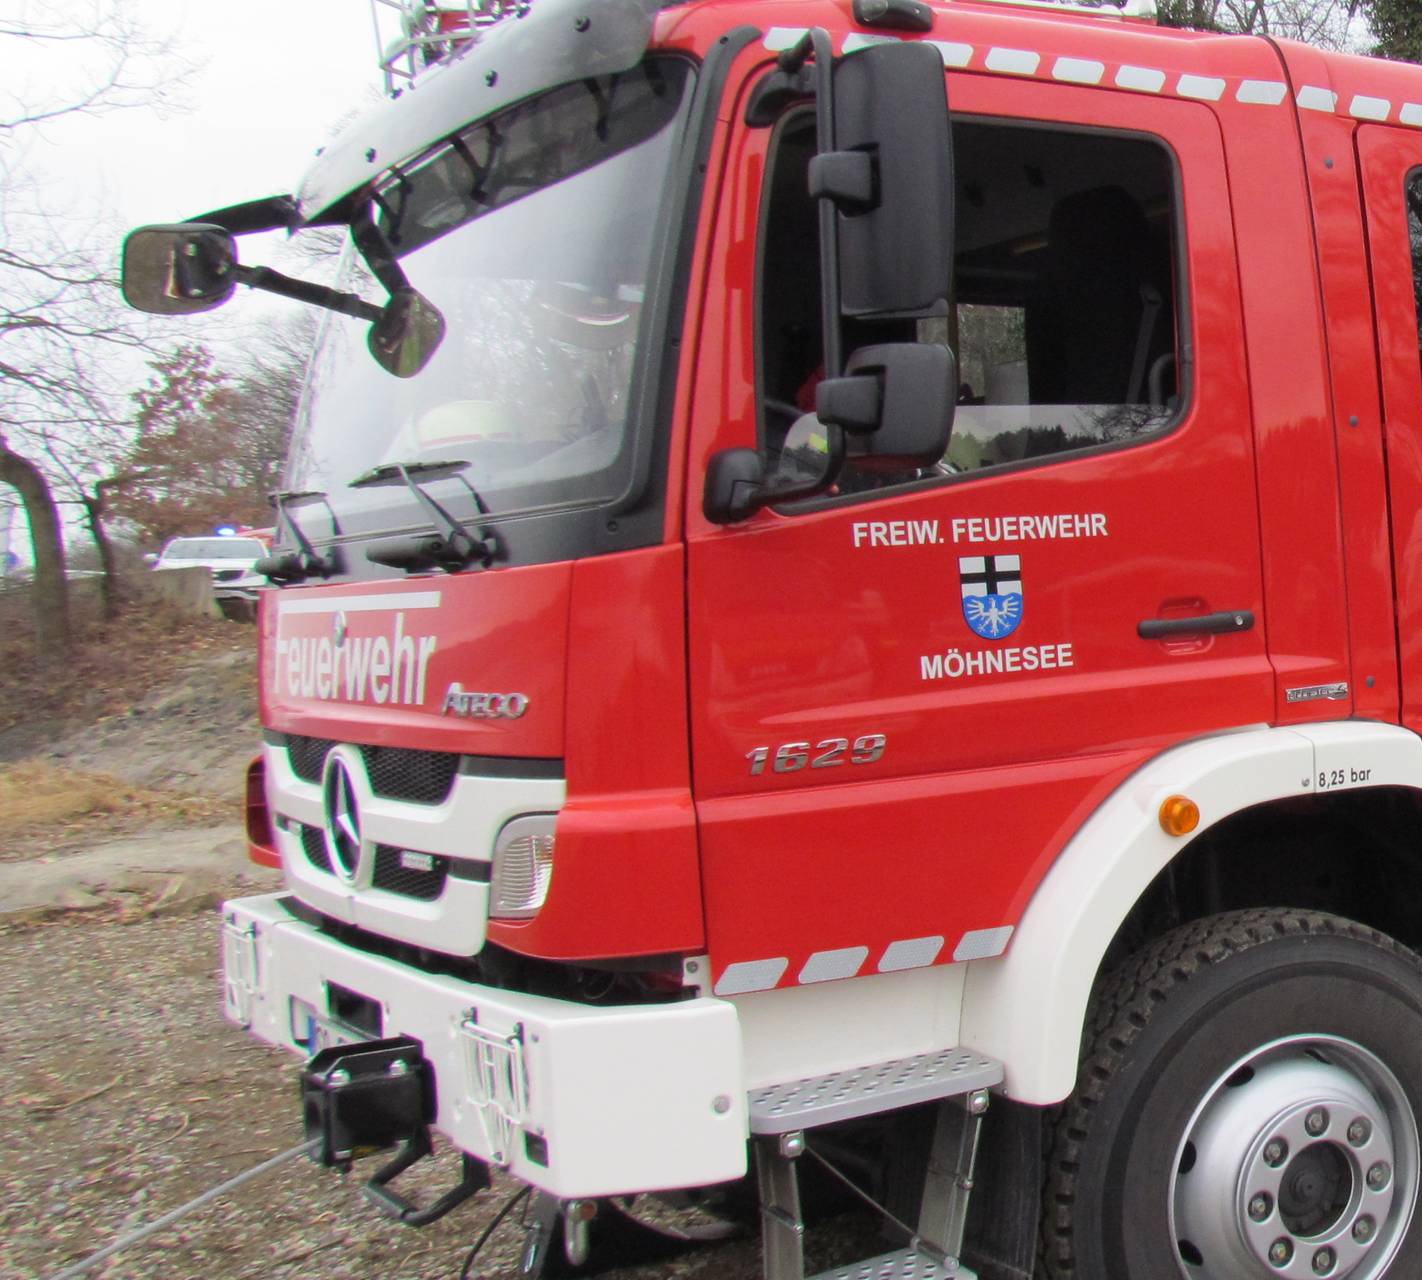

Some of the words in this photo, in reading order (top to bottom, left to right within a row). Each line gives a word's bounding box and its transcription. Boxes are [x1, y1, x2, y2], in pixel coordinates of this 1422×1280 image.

[853, 520, 945, 548] FREIW.
[951, 513, 1108, 543] FEUERWEHR
[273, 591, 441, 705] Feuerwehr
[920, 643, 1074, 680] MÖHNESEE
[745, 733, 887, 776] 1629
[1318, 769, 1345, 790] 8,25
[1350, 767, 1371, 783] bar
